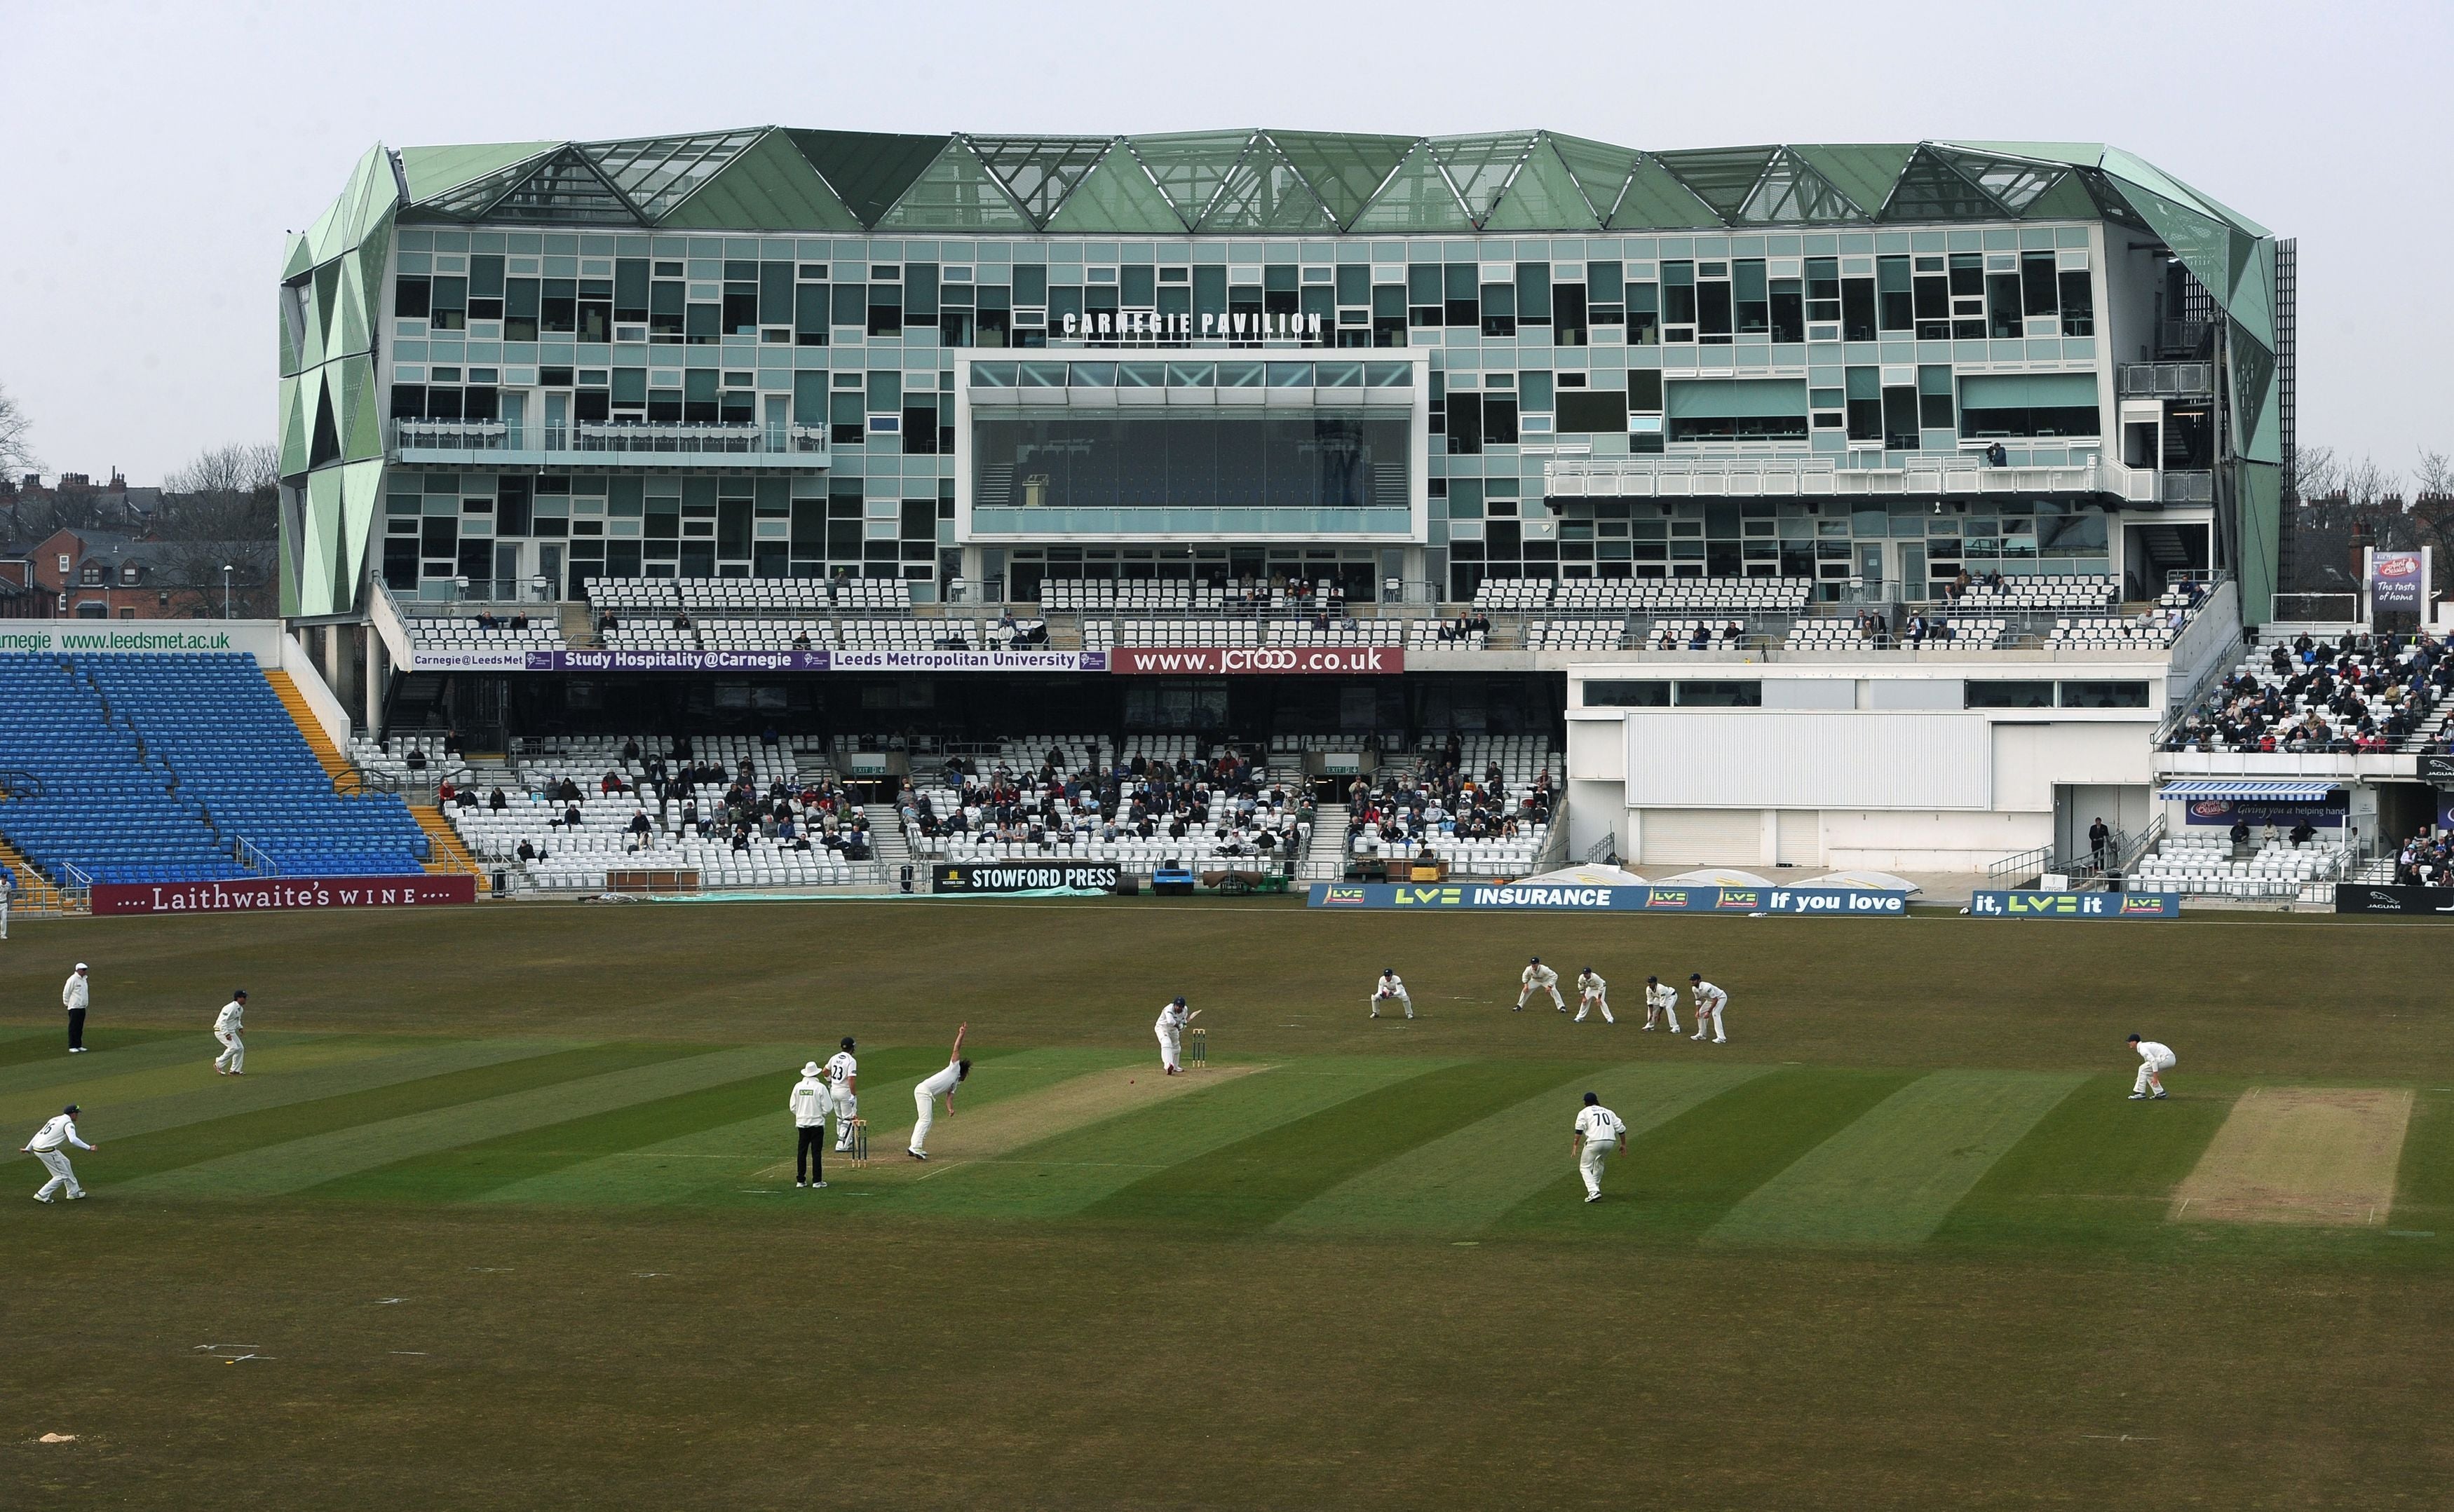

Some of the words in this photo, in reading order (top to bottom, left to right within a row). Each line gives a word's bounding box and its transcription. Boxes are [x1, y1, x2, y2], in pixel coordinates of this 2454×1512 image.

[1063, 313, 1190, 334] CARNEGIE
[1201, 313, 1321, 334] PAVILION
[2378, 581, 2393, 591] The
[2395, 582, 2415, 591] taste
[2379, 591, 2389, 601] of
[2389, 592, 2413, 601] home
[62, 632, 230, 649] www.leedsmet.ac.uk
[504, 655, 523, 665] Met
[564, 652, 612, 669] Study
[616, 652, 792, 669] Hospitality@Carnegie
[834, 653, 882, 666] Leeds
[887, 652, 989, 669] Metropolitan
[994, 652, 1076, 669] University
[2237, 805, 2266, 819] Giving
[2266, 807, 2284, 819] you
[2295, 807, 2324, 817] helping
[972, 869, 1060, 887] STOWFORD
[1065, 869, 1116, 887] PRESS
[152, 882, 330, 910] Laithwaite's
[339, 889, 416, 904] WINE
[1474, 889, 1612, 906] INSURANCE
[1770, 892, 1791, 908] If
[1796, 896, 1840, 912] you
[1849, 894, 1901, 910] love
[1976, 895, 2002, 915] it,
[2083, 897, 2103, 913] it
[833, 1065, 843, 1080] 23
[1593, 1112, 1610, 1126] 70
